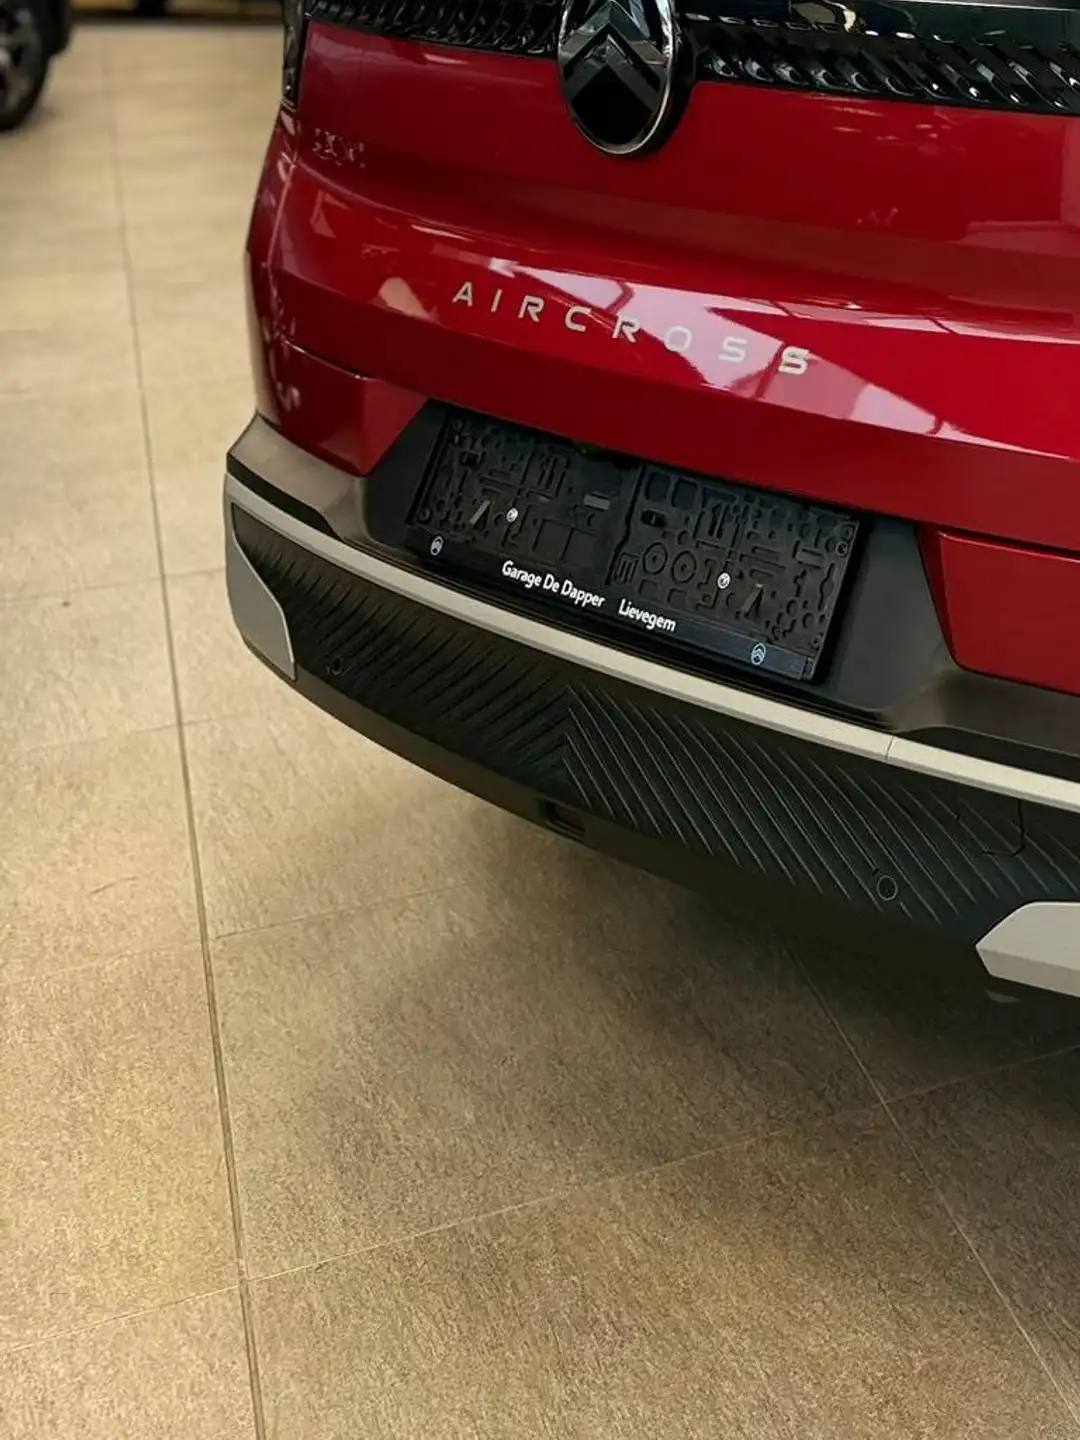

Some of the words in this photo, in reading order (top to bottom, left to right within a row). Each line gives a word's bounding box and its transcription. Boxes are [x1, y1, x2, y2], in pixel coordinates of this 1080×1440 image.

[452, 281, 811, 375] AIRCROSS
[502, 560, 542, 589] Garage
[543, 574, 560, 593] De
[561, 580, 606, 607] Dapper
[618, 598, 677, 632] Lievegem
